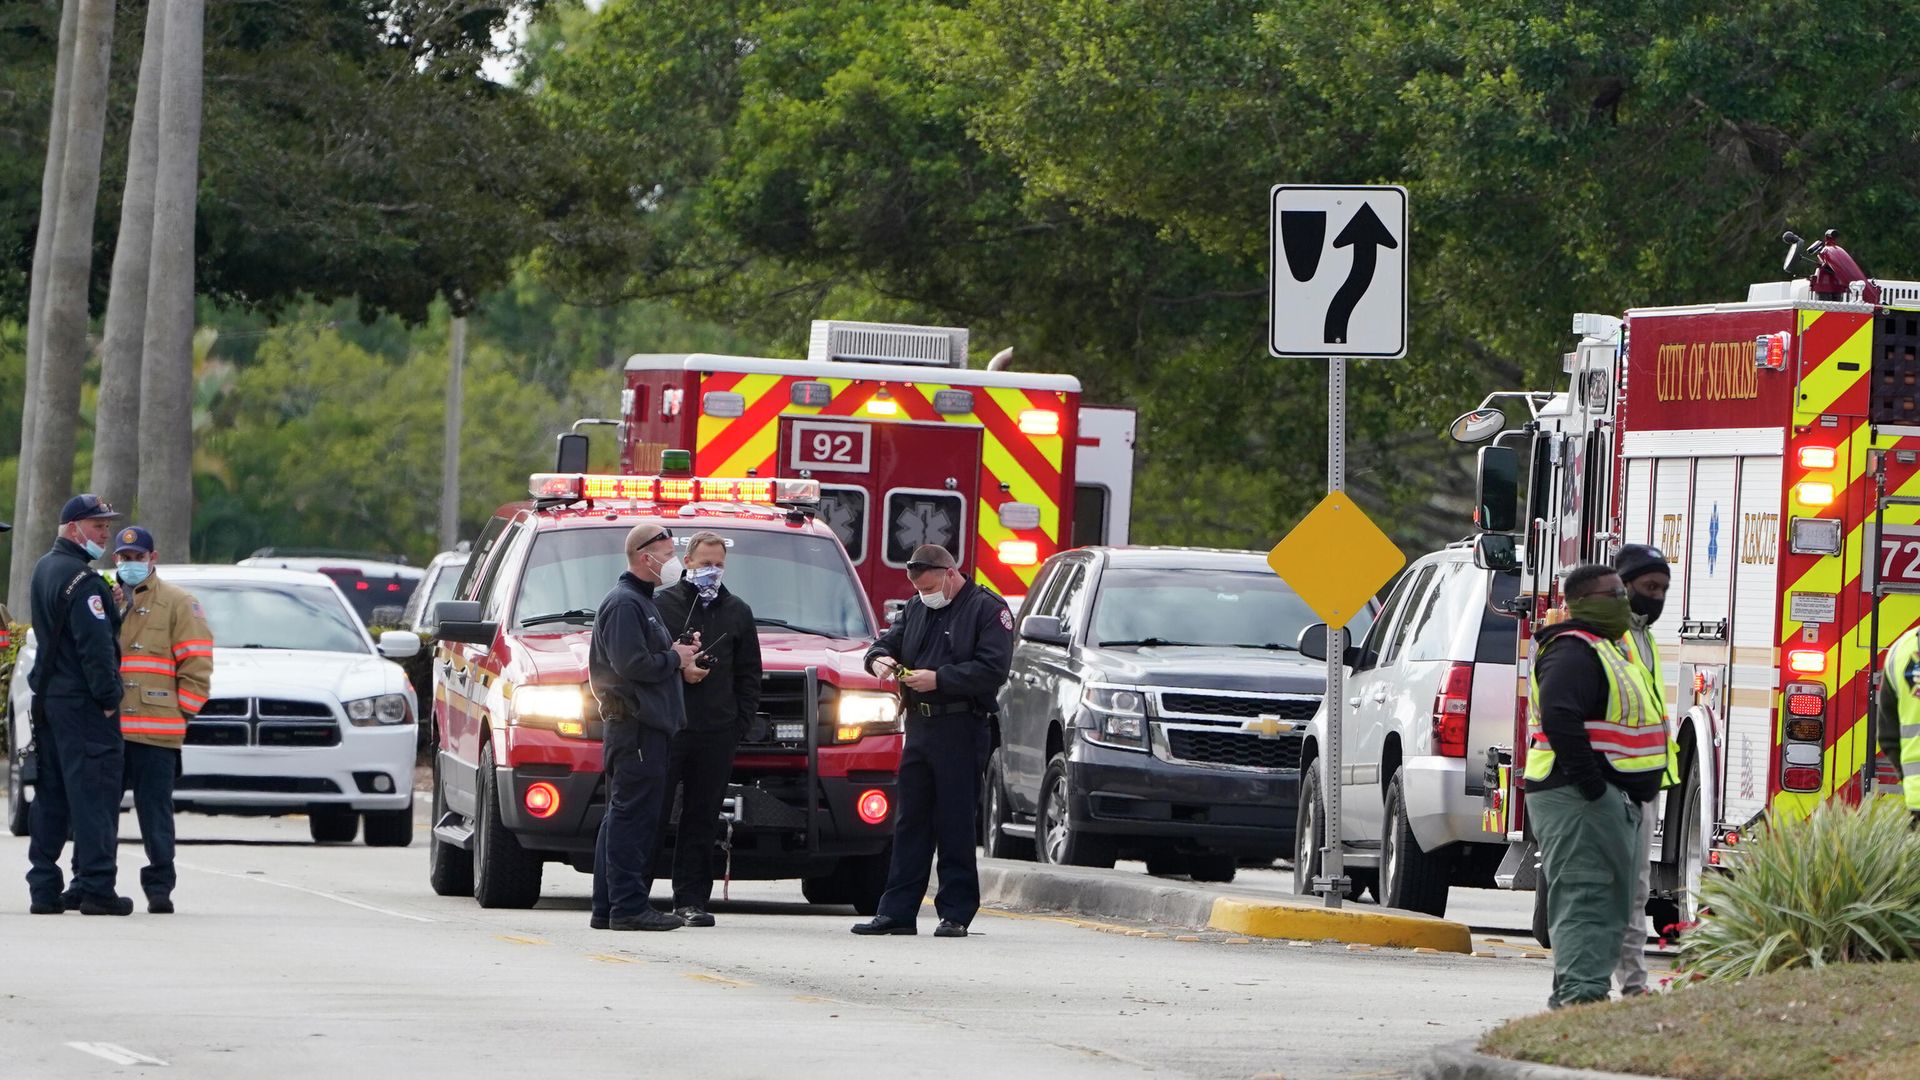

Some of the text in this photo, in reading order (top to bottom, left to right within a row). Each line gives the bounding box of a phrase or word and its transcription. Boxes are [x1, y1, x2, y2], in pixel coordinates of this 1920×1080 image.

[1657, 341, 1758, 401] CITY OF SUNRISE
[813, 433, 852, 462] 92
[1661, 512, 1778, 564] FIRE RESCUE
[1881, 540, 1920, 578] 72
